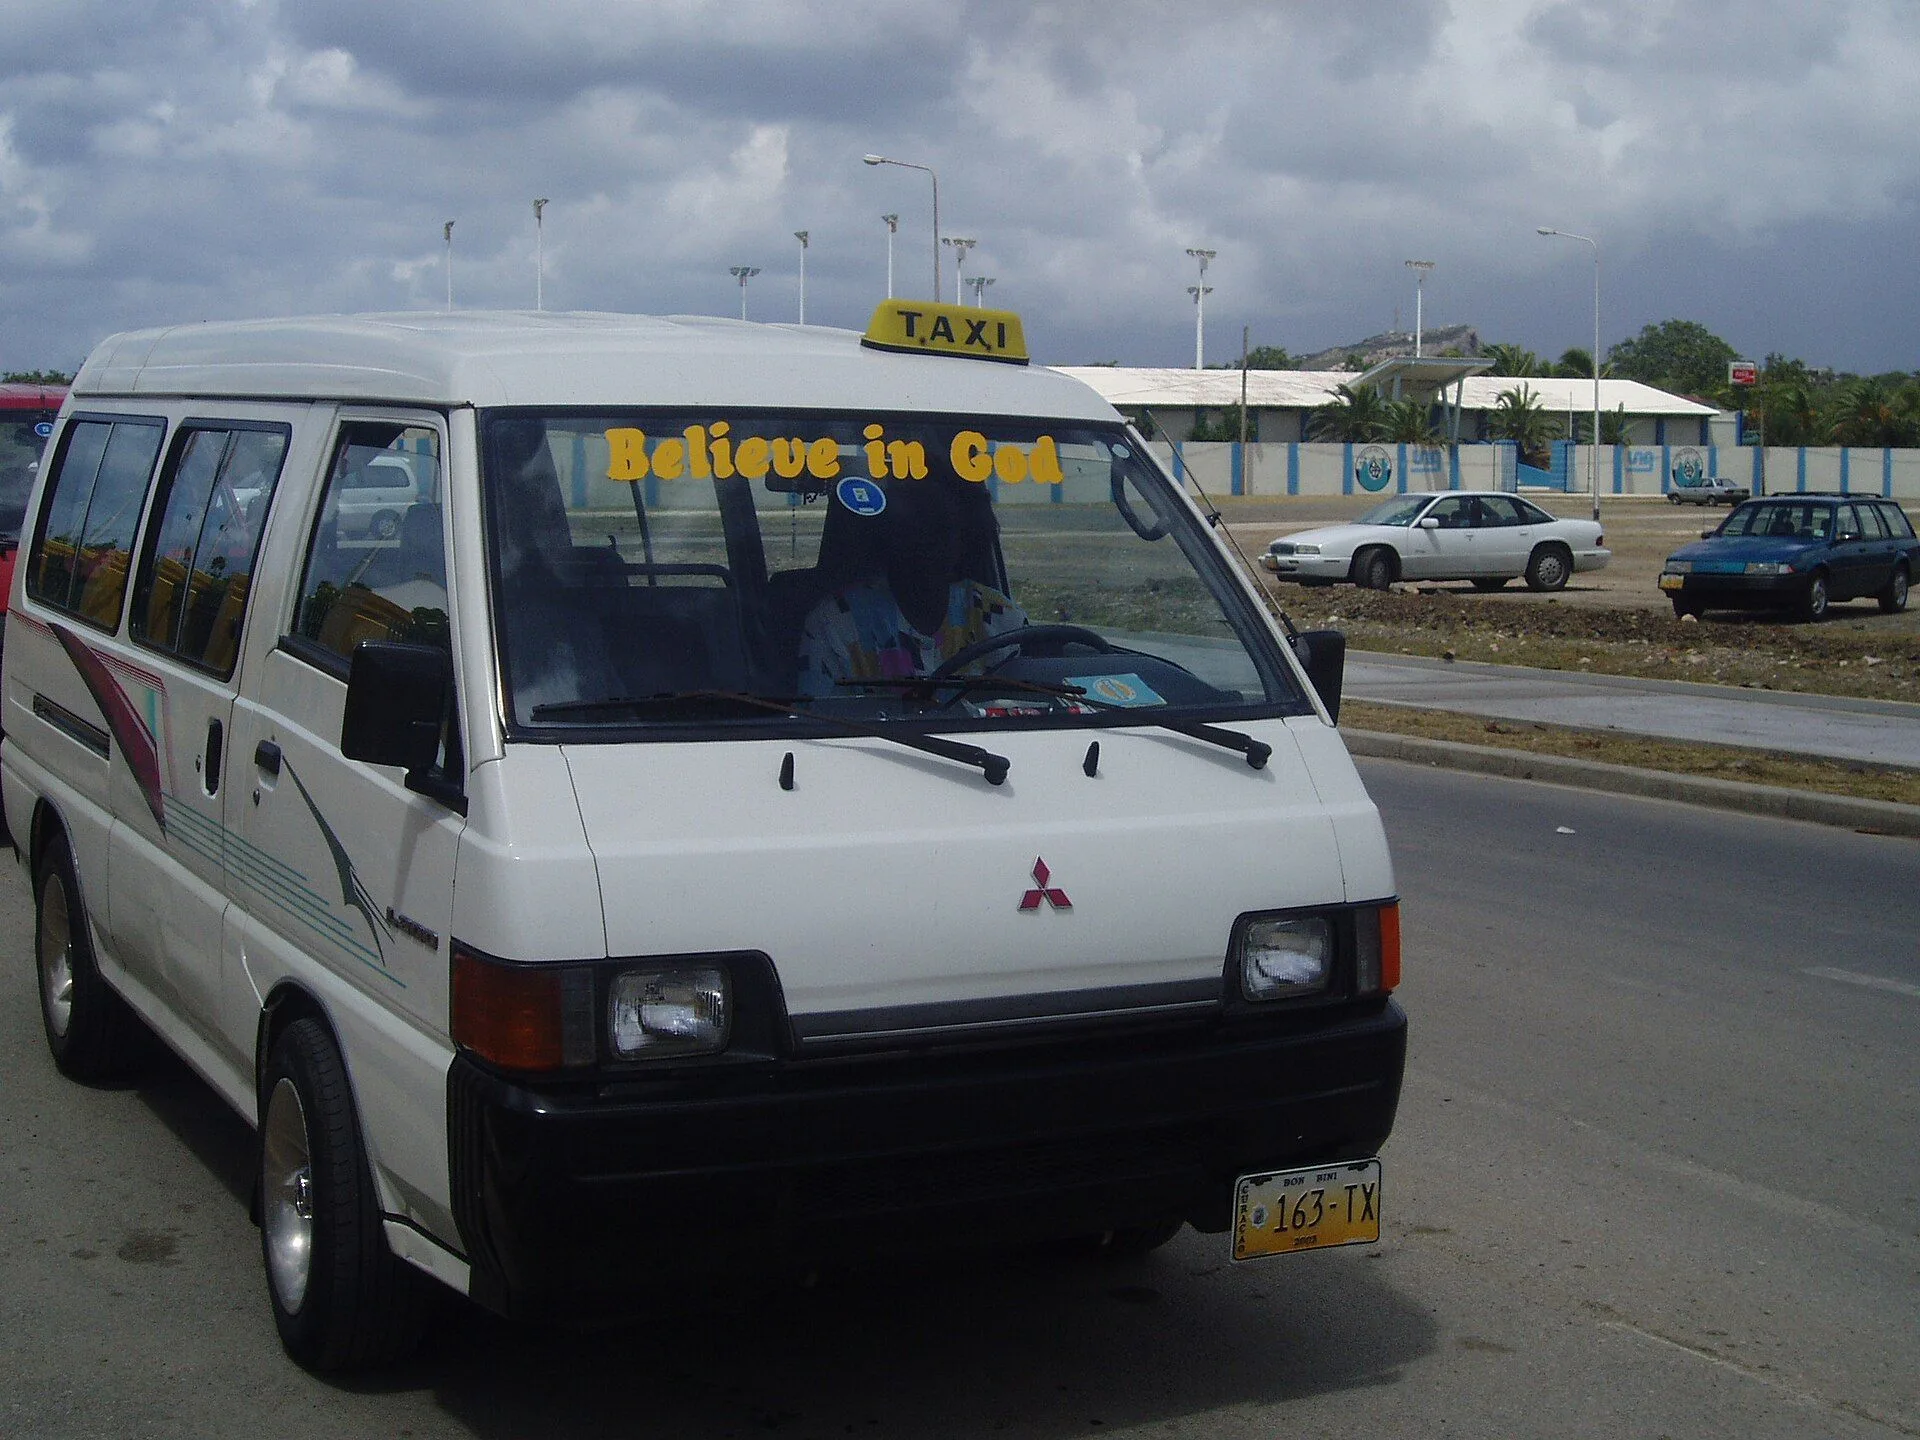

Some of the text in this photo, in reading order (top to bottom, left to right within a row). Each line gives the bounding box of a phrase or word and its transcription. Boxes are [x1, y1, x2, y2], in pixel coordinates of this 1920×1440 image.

[897, 310, 1005, 348] TAXI
[605, 421, 1065, 484] Believe in God
[1316, 1172, 1338, 1183] BINI
[1273, 1181, 1375, 1234] 163-TX
